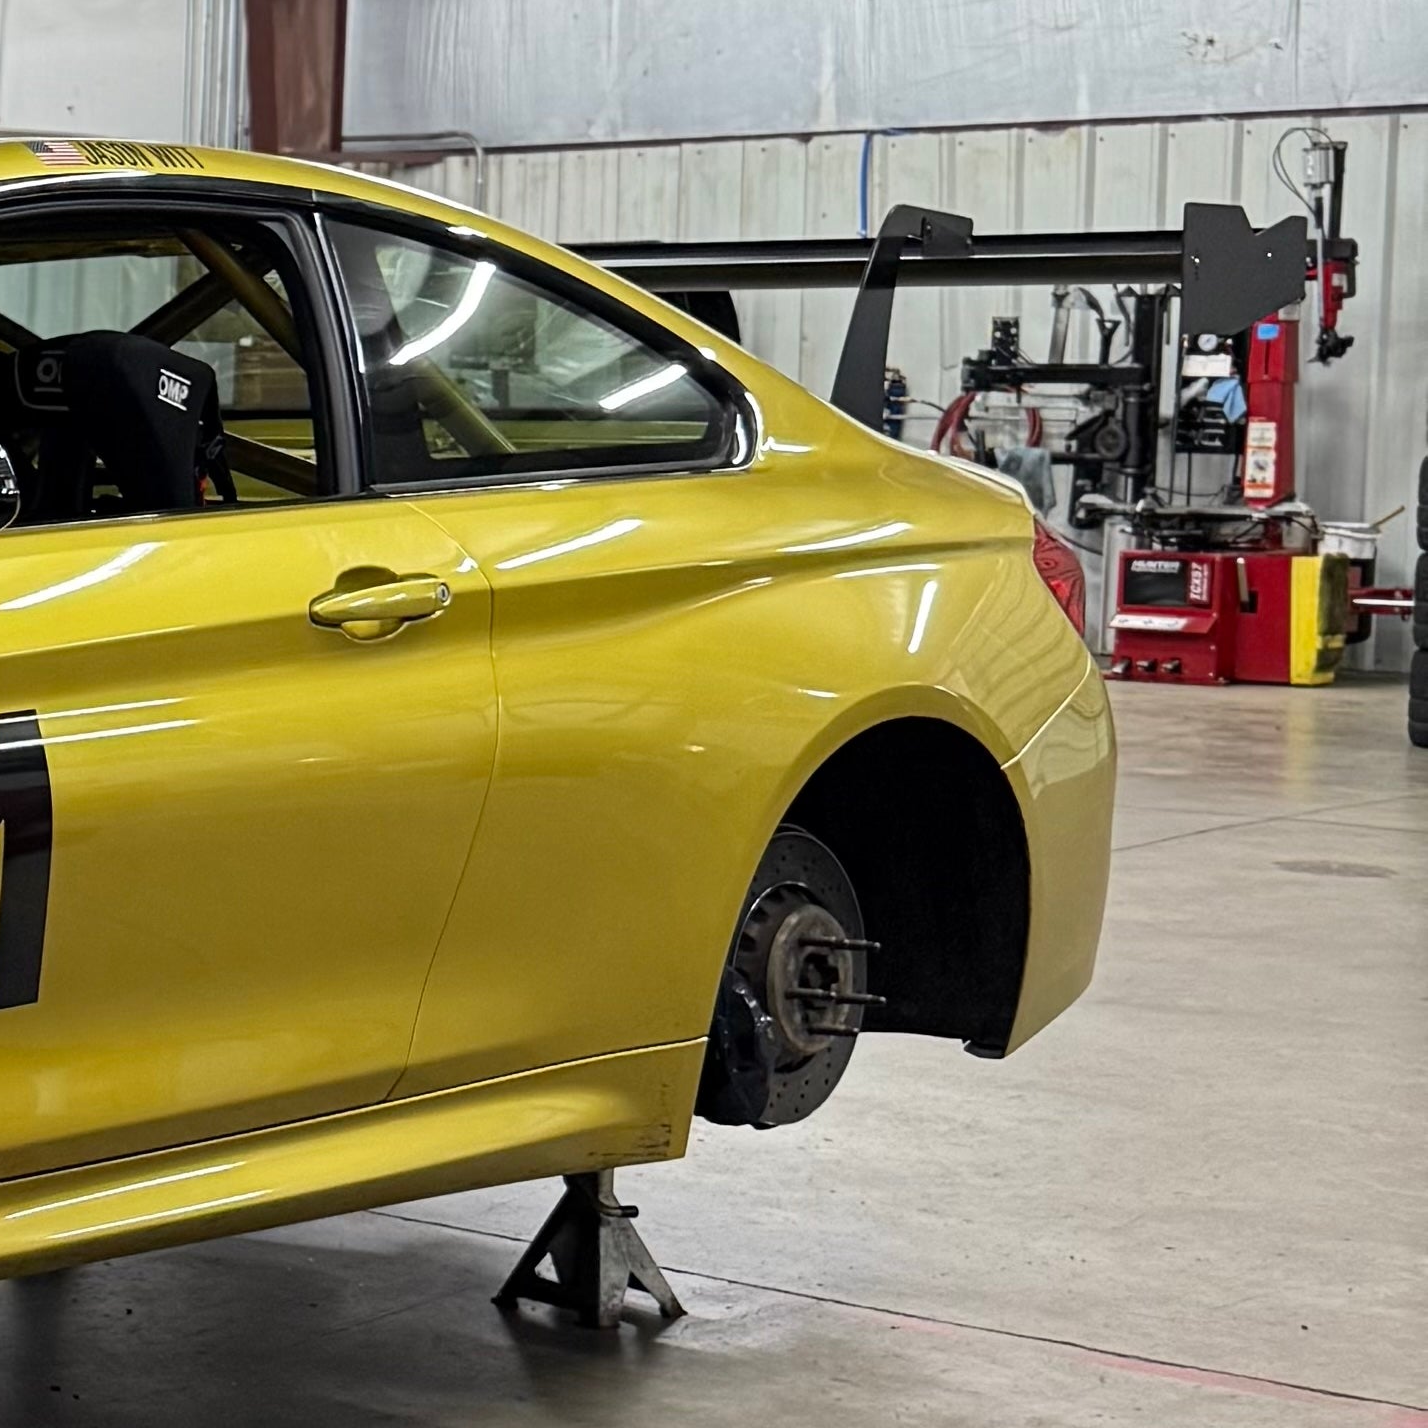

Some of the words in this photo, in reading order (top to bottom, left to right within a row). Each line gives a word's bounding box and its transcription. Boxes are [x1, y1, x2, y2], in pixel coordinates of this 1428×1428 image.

[78, 140, 154, 167] JASON
[143, 144, 204, 169] WITT
[158, 375, 189, 403] OMP
